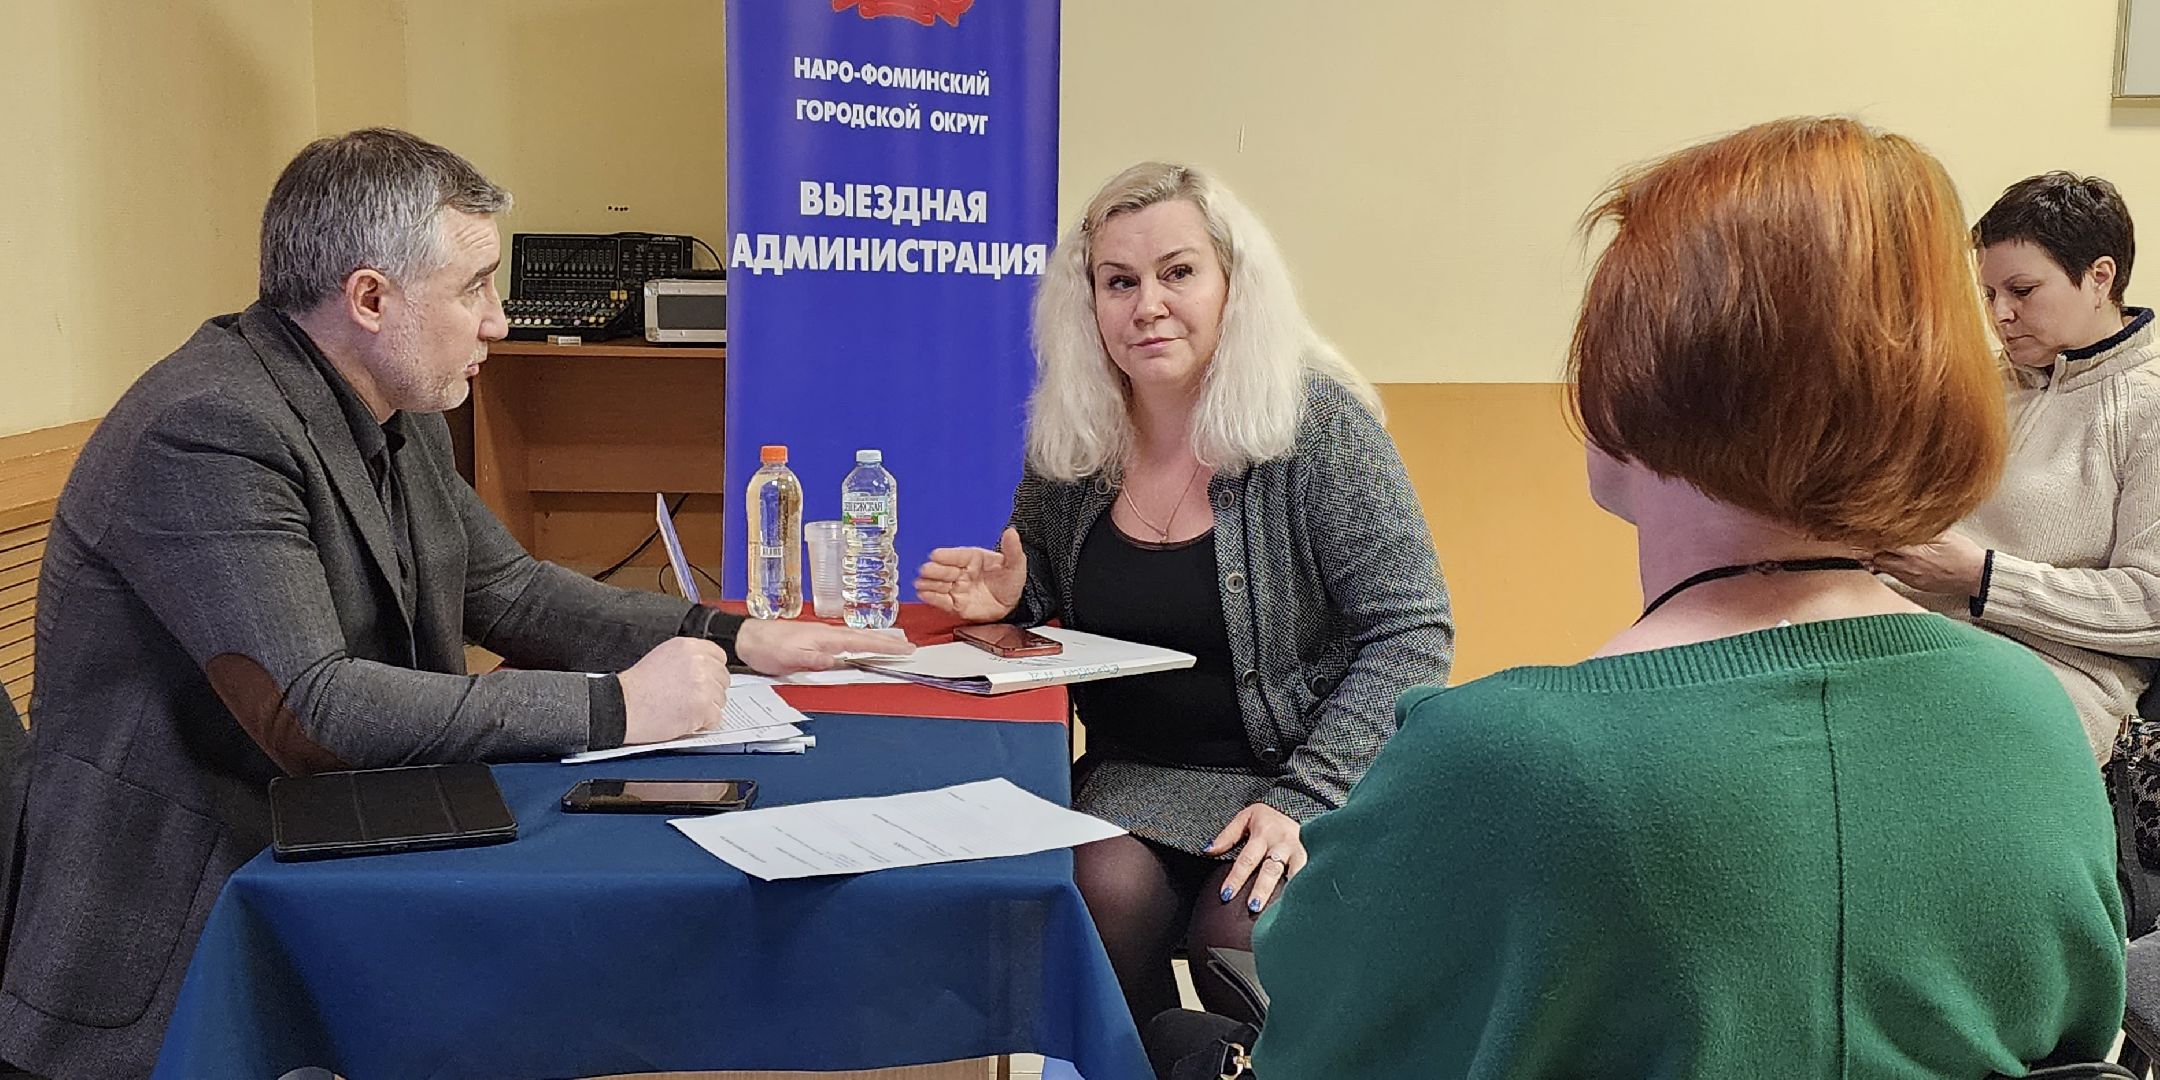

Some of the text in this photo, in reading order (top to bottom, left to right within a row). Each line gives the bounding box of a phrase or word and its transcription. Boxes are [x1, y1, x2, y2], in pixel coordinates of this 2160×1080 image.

[794, 56, 989, 96] НАРО-ФОМИНСКИЙ
[796, 98, 988, 135] ГОРОДСКОЙ ОКРУГ
[800, 180, 987, 226] ВЫЕЗДНАЯ
[731, 233, 1047, 279] АДМИНИСТРАЦИЯ
